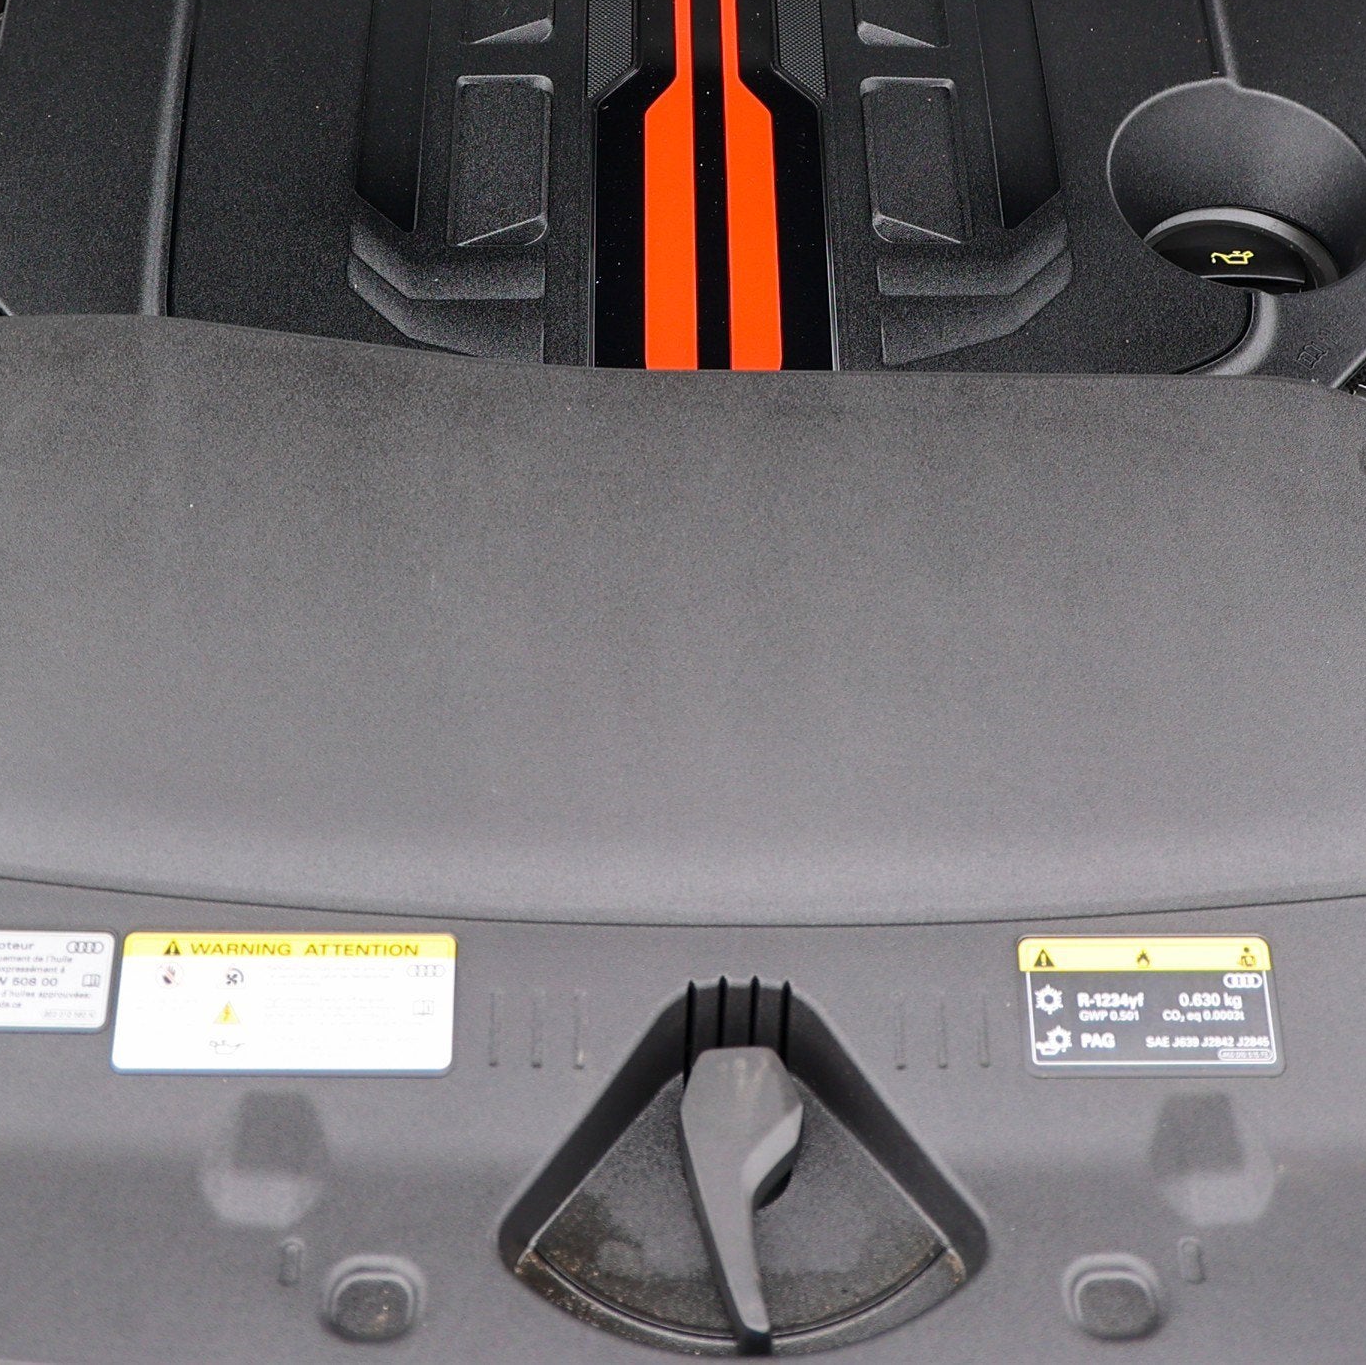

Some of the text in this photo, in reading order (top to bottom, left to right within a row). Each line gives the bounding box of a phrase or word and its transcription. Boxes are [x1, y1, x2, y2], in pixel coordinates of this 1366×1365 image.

[190, 943, 419, 957] WARNING ATTENTION
[41, 977, 58, 987] 00
[1077, 992, 1243, 1011] R-1234yf 0.630 kg
[1078, 1009, 1109, 1022] GWP
[1080, 1032, 1116, 1049] PAG
[1145, 1035, 1170, 1048] SAE
